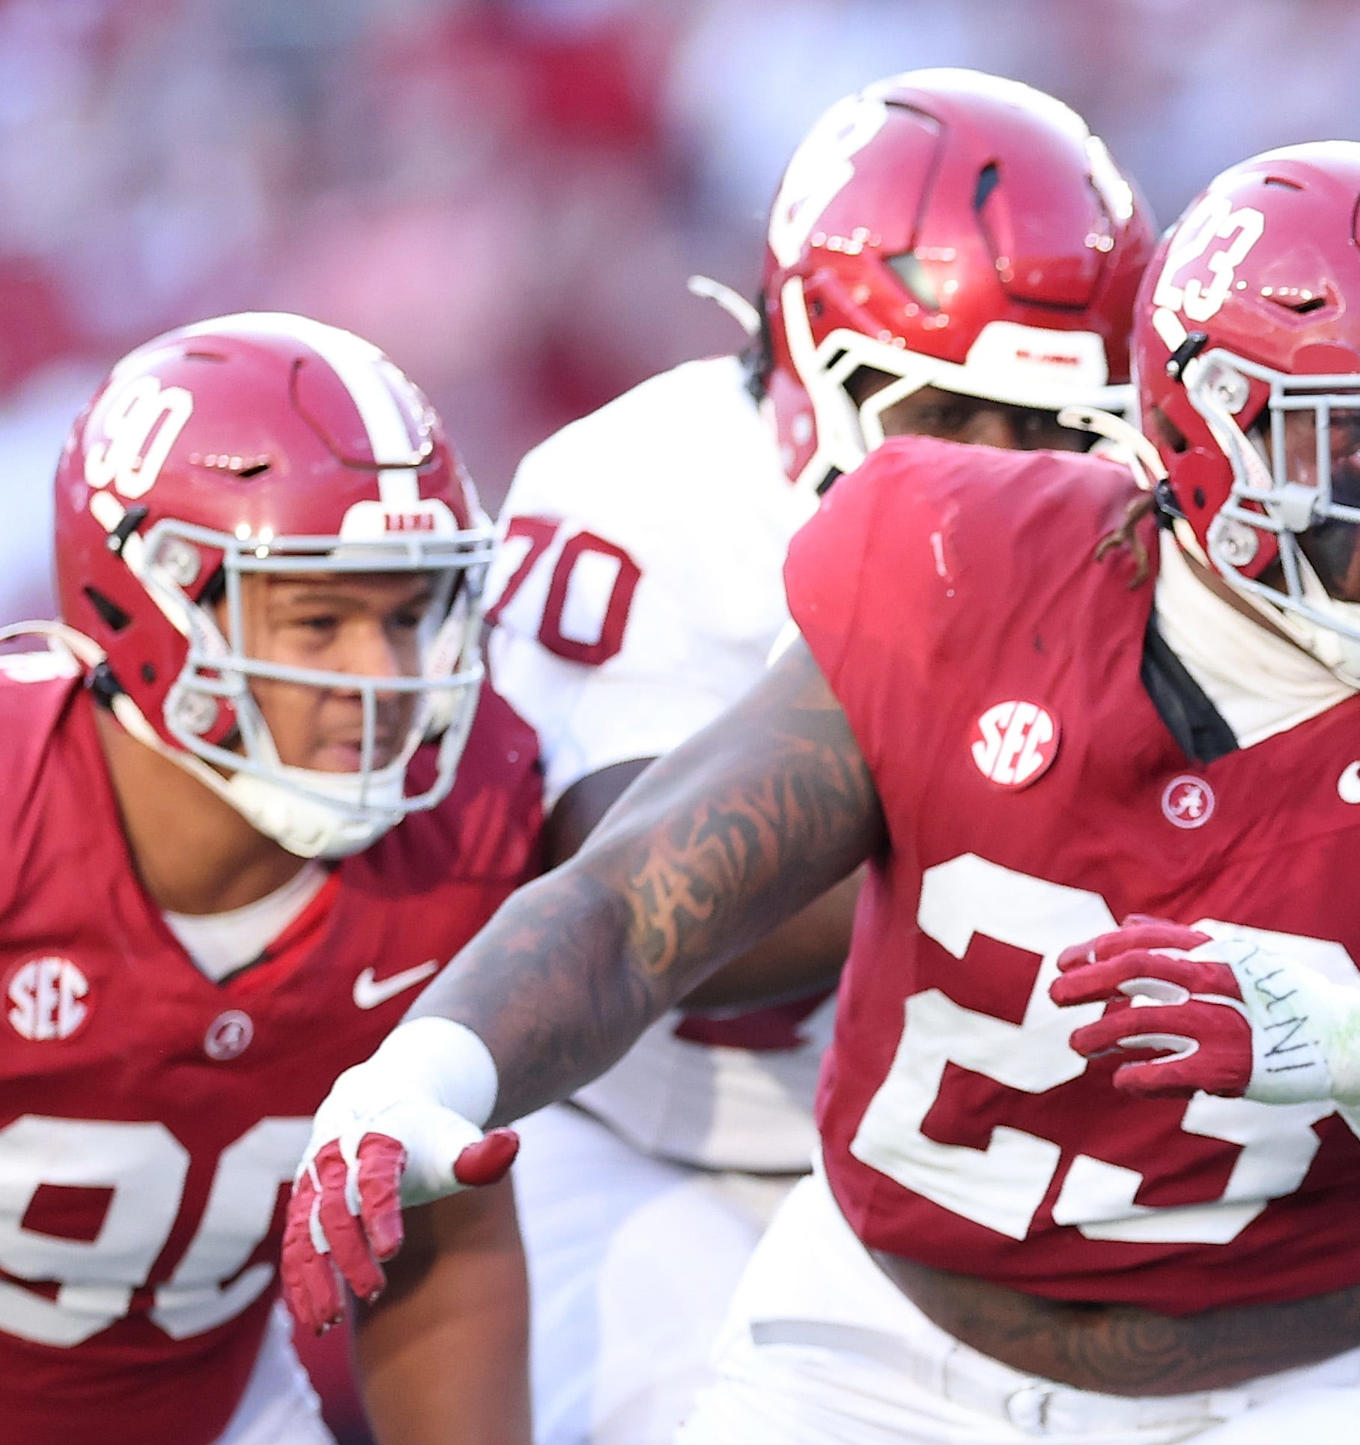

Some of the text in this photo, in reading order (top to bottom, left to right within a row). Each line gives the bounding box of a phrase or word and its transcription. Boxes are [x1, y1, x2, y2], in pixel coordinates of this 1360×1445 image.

[1152, 196, 1265, 322] 23
[85, 375, 194, 500] 90
[484, 516, 641, 665] 70
[970, 700, 1054, 785] SEC
[8, 955, 89, 1041] SEC
